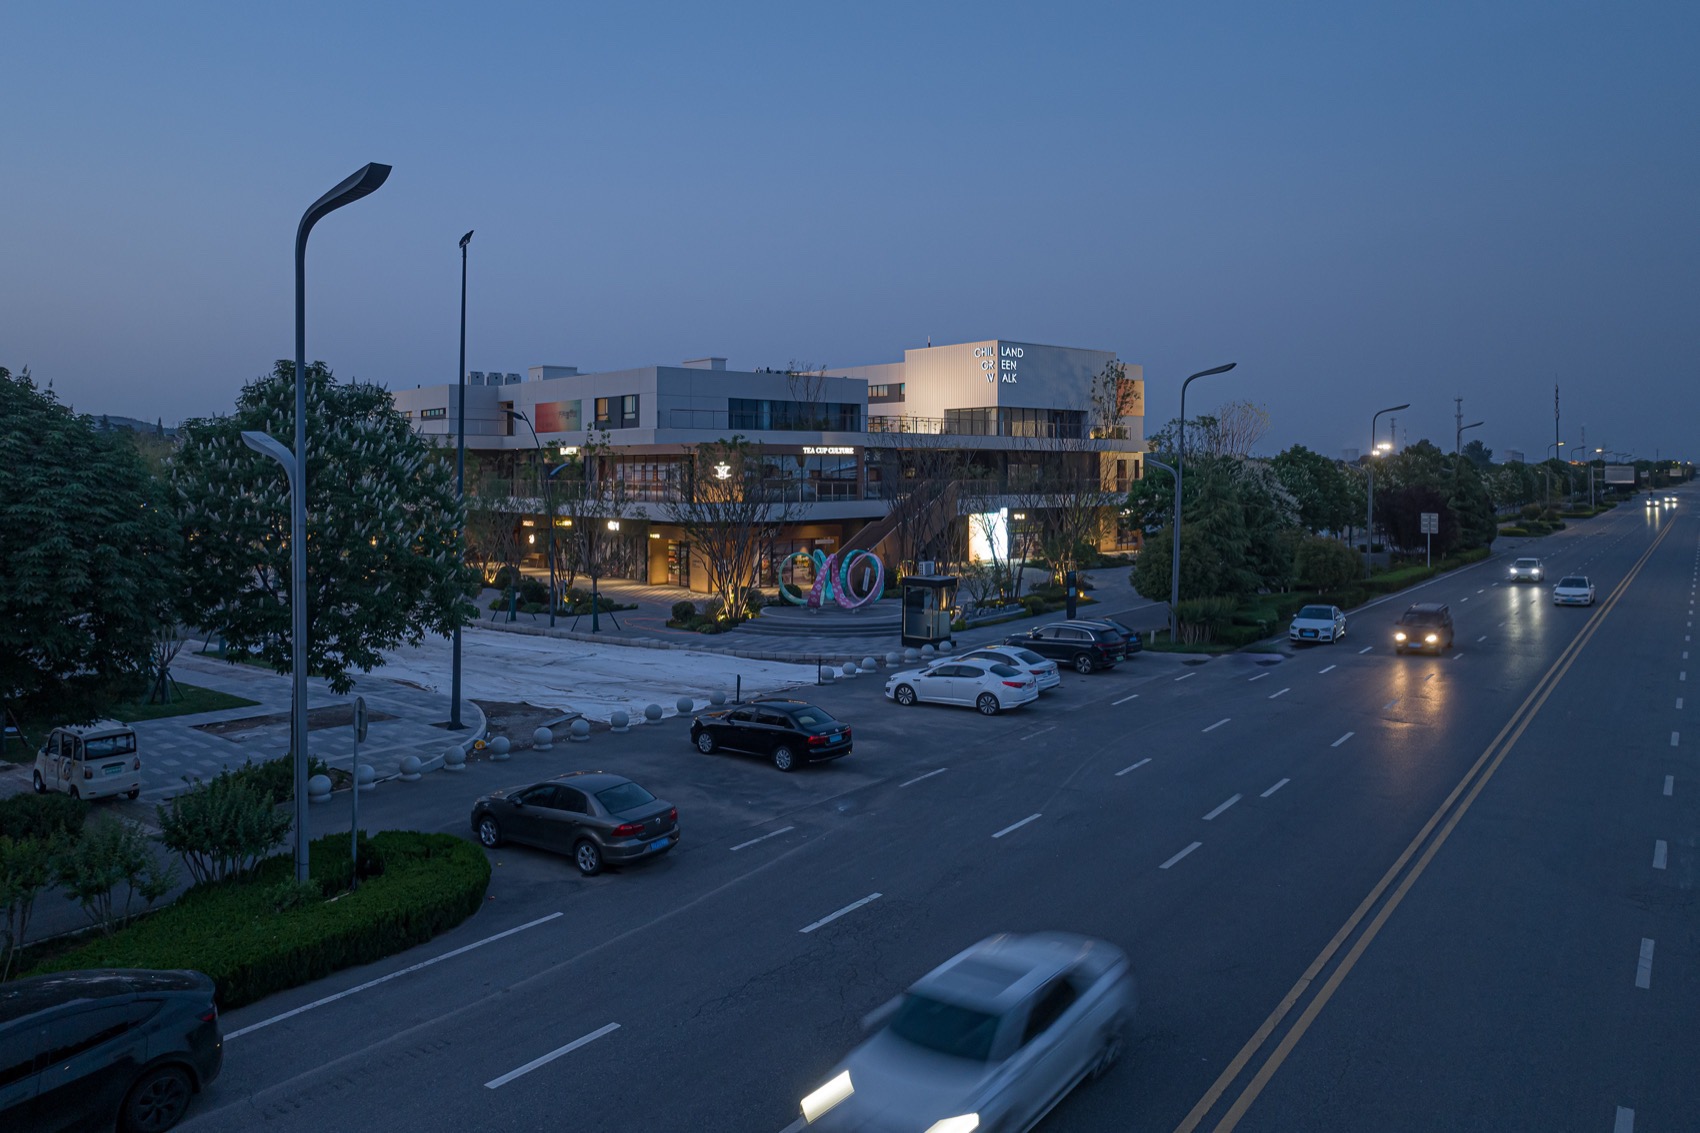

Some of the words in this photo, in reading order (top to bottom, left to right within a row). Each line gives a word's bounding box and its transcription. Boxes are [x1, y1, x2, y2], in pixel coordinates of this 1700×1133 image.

[1001, 346, 1024, 358] LAND
[1001, 360, 1017, 370] EEN
[985, 373, 995, 383] W
[1002, 373, 1017, 383] ALK
